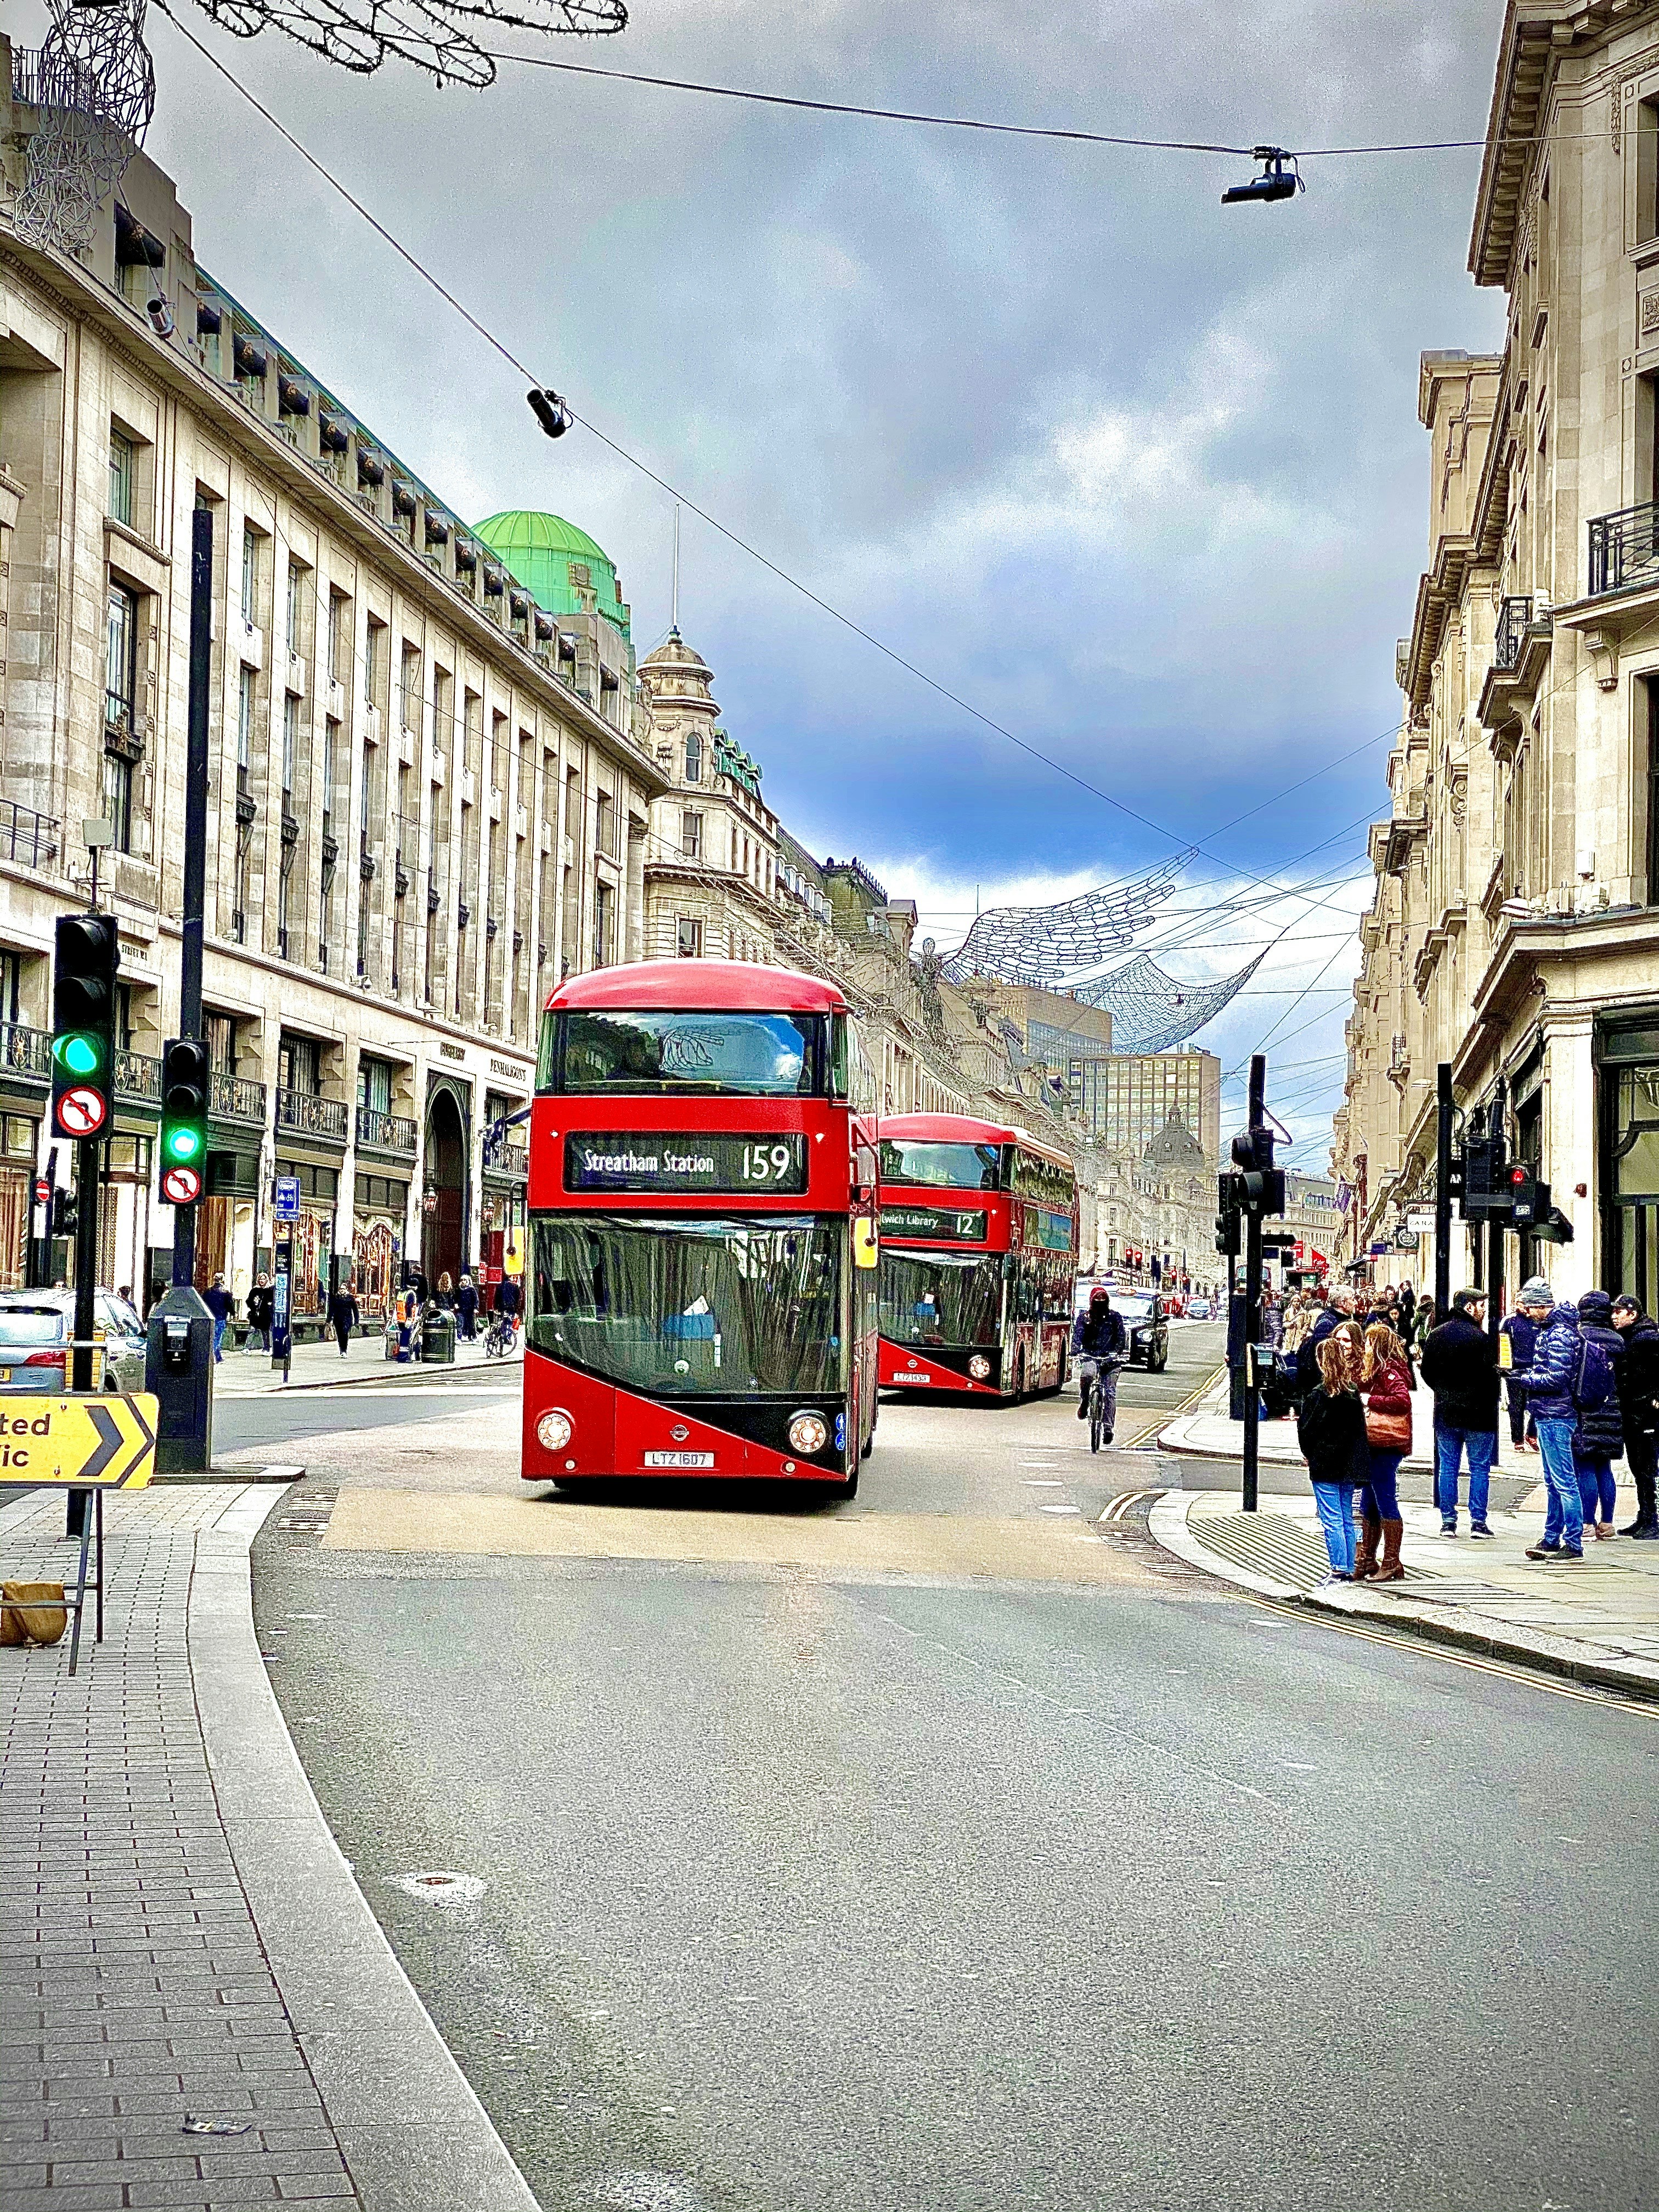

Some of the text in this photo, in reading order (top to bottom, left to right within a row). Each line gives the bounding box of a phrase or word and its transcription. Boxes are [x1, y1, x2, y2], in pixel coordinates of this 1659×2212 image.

[121, 944, 139, 958] STREET
[490, 1058, 526, 1082] PENHALIGON'S
[584, 1145, 790, 1180] Streatham Station 159
[906, 1215, 938, 1229] Library
[956, 1216, 973, 1234] 12
[0, 1444, 29, 1467] ic
[652, 1453, 707, 1465] LTZ 1607
